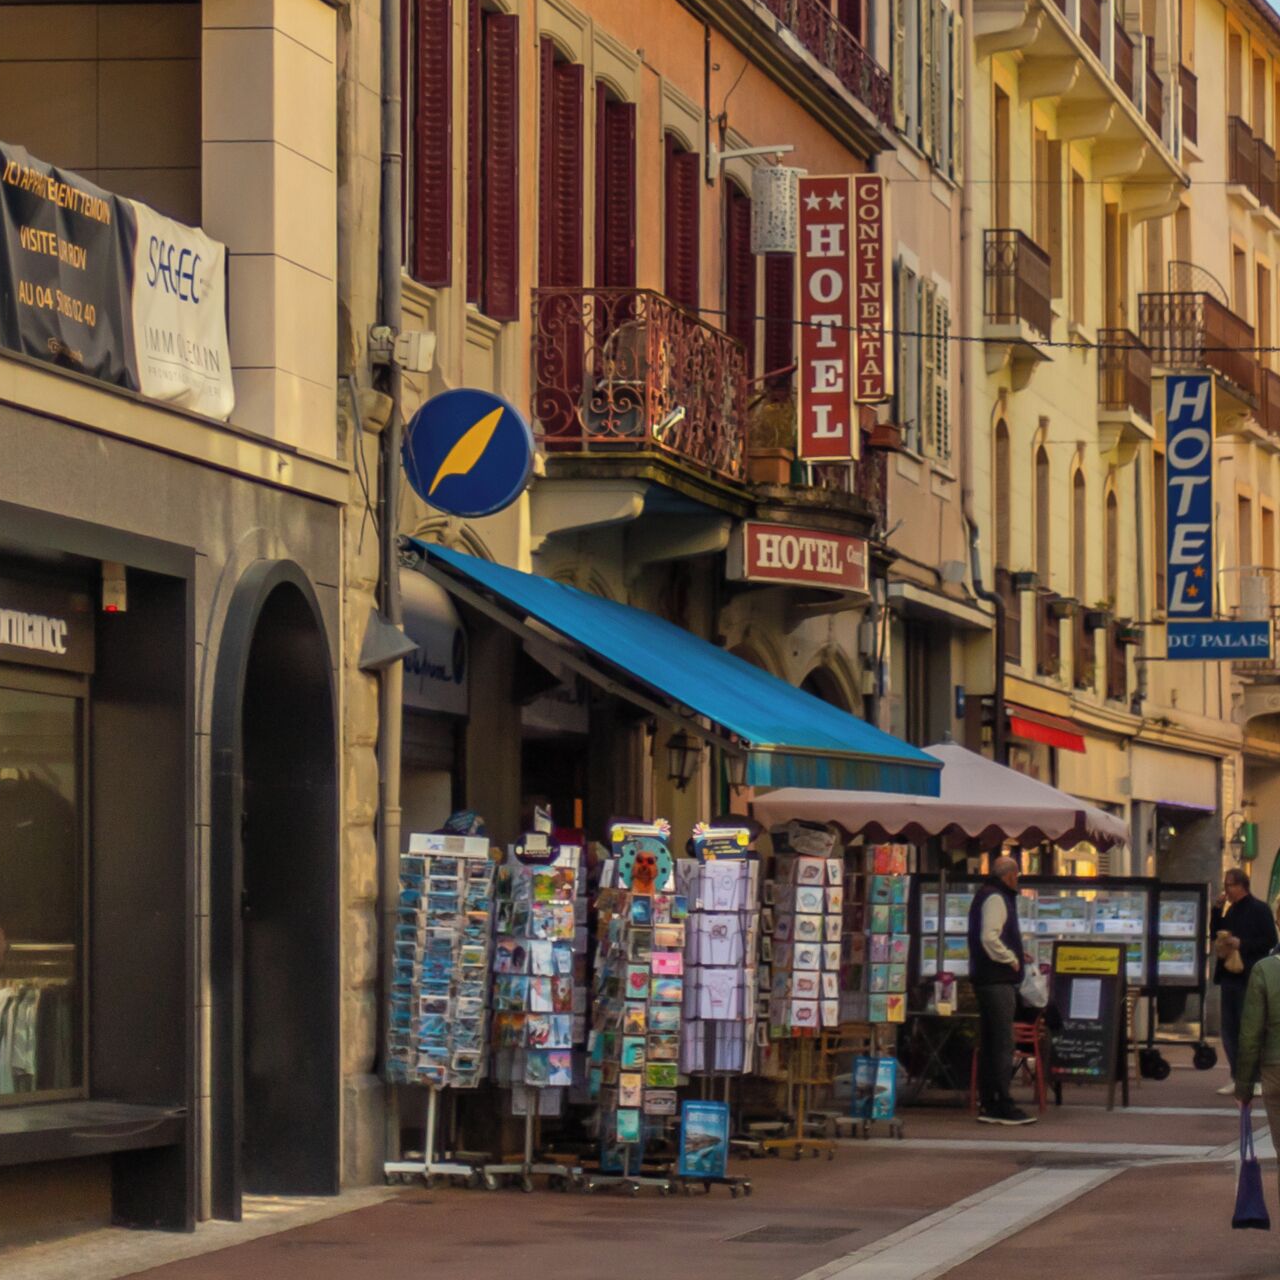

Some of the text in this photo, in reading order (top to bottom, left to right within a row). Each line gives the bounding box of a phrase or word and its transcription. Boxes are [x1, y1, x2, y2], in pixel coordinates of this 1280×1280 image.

[20, 225, 58, 257] VISITE
[18, 279, 34, 306] AU
[858, 183, 881, 396] CONTINENTAL
[806, 223, 845, 439] HOTEL
[1167, 380, 1211, 613] HOTEL
[756, 533, 843, 575] HOTEL
[1167, 632, 1270, 648] DU PALAIS
